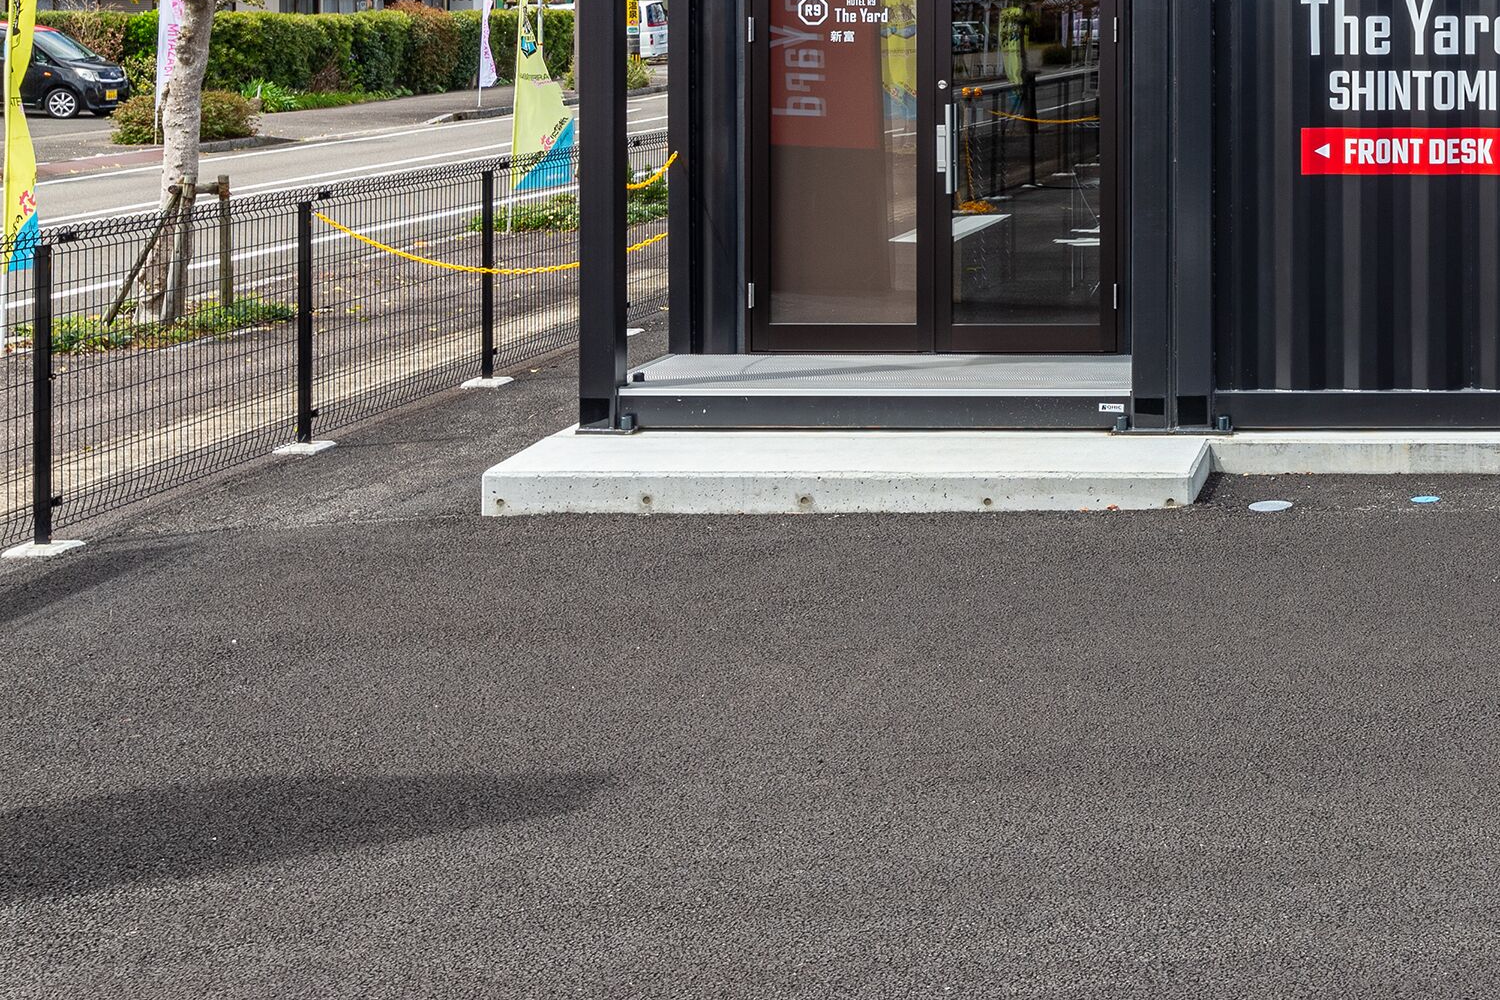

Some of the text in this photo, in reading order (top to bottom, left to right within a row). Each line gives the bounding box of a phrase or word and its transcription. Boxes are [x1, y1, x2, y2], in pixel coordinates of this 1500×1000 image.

[805, 4, 821, 17] R9
[835, 8, 888, 23] The Yard
[831, 31, 855, 42] 新富
[1329, 70, 1497, 111] SHINTOMI
[1345, 138, 1493, 164] FRONT DESK
